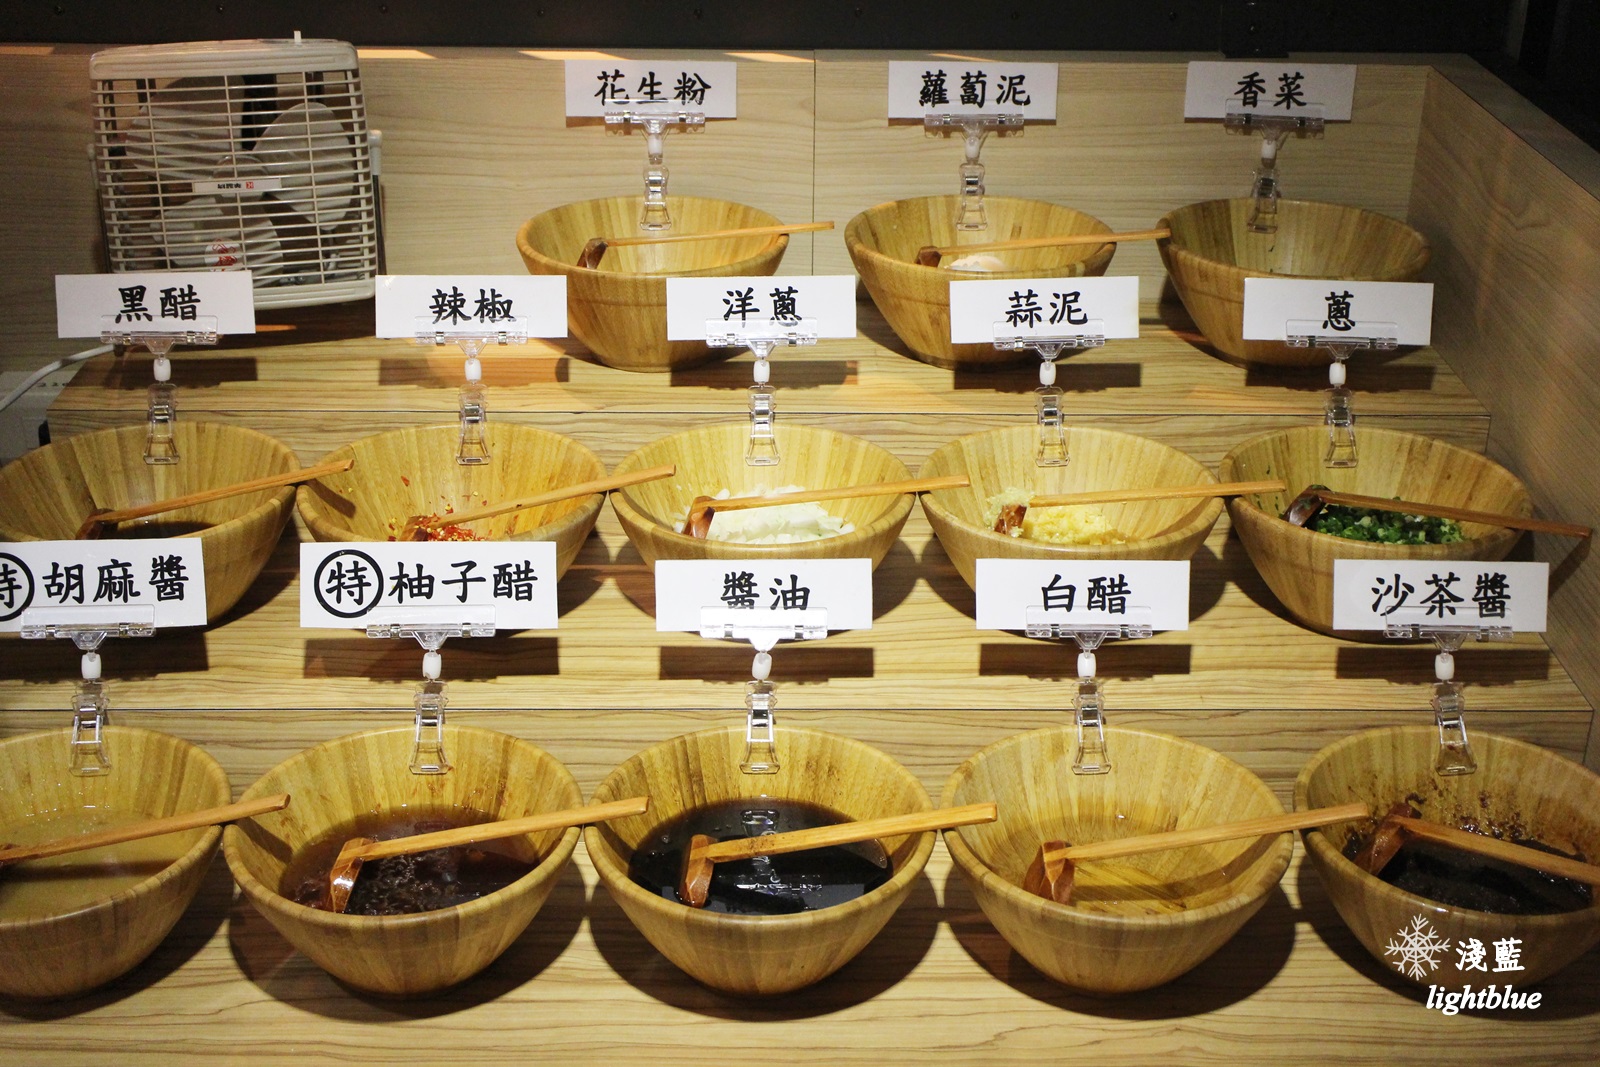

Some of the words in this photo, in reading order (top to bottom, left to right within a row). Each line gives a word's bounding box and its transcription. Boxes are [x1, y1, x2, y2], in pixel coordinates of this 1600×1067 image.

[594, 68, 712, 109] 花生粉
[919, 70, 1031, 109] 蘿蔔泥
[1234, 71, 1307, 110] 香菜
[115, 285, 202, 325] 黑醋
[429, 286, 516, 327] 辣椒
[722, 285, 803, 328] 洋蔥
[1005, 288, 1088, 330] 蒜泥
[1323, 290, 1356, 332] 蔥
[720, 571, 810, 611] 醬油
[1041, 573, 1133, 615] 白醋
[1371, 571, 1512, 619] 沙茶醬
